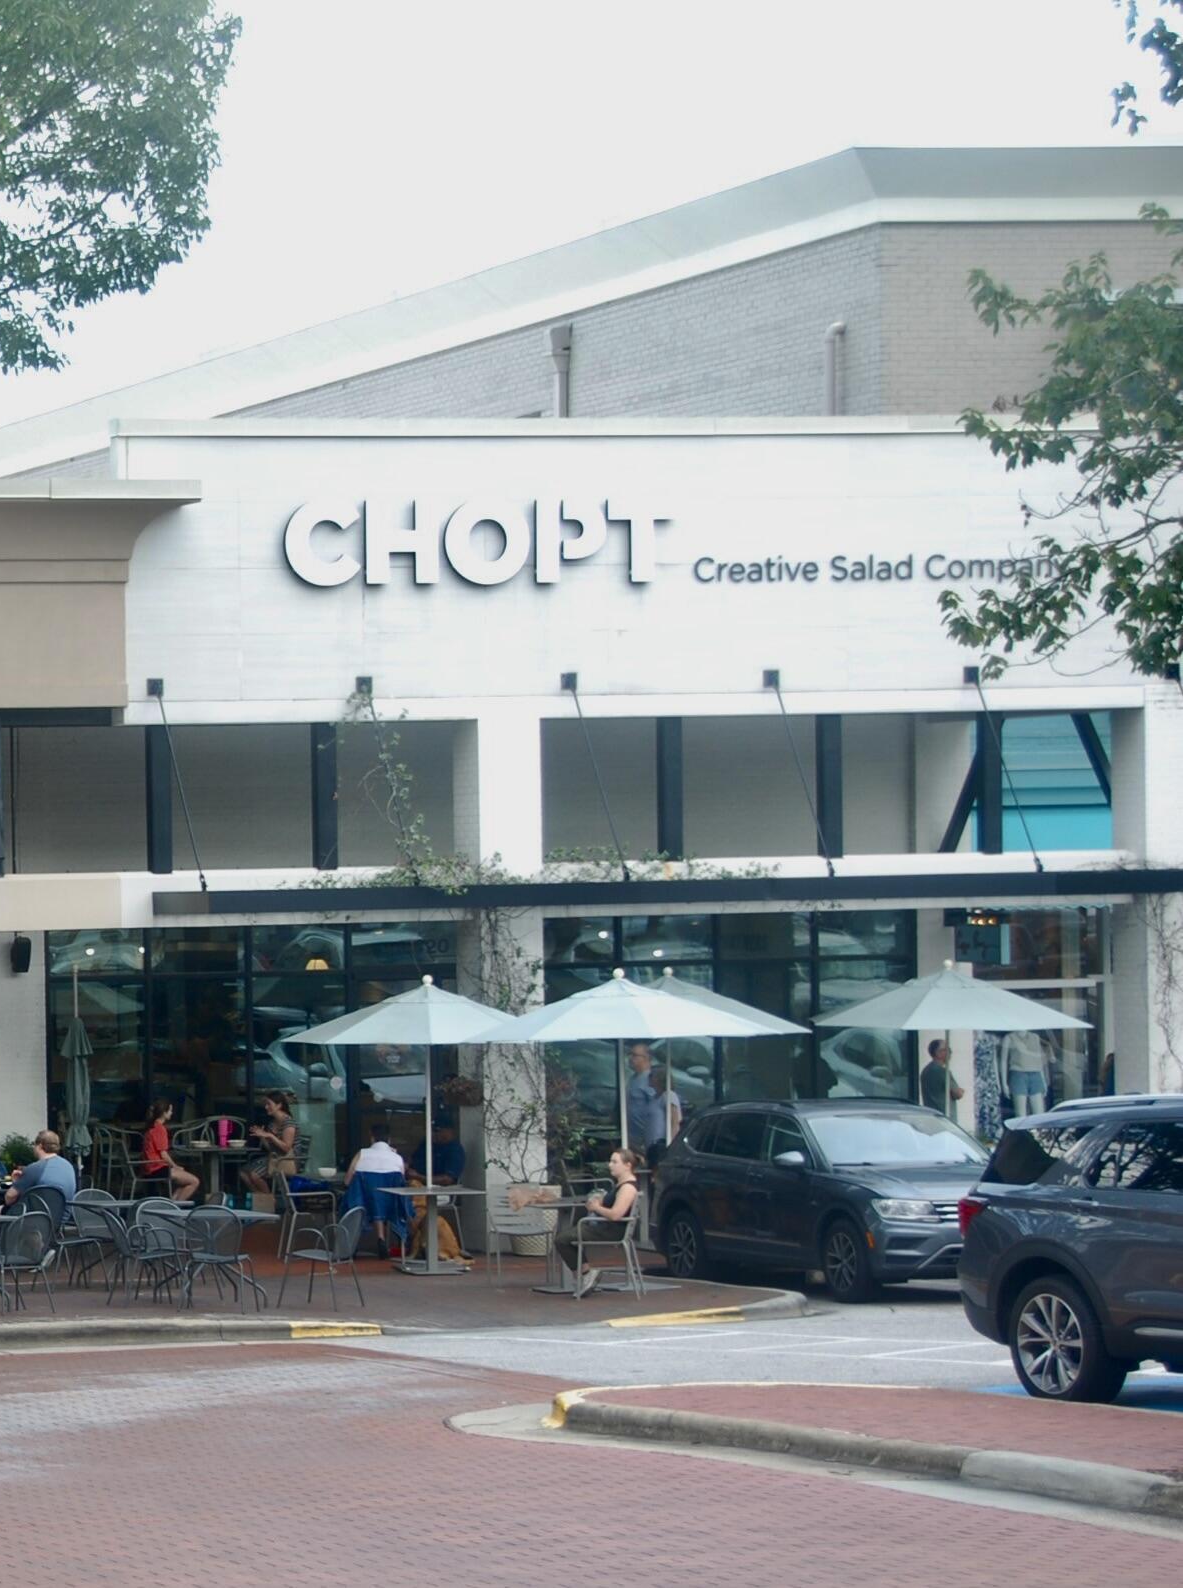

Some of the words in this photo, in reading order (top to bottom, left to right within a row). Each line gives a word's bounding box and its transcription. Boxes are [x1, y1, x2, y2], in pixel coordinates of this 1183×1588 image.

[284, 498, 673, 588] CHOPT
[693, 555, 818, 582] Creative
[829, 554, 913, 582] Salad
